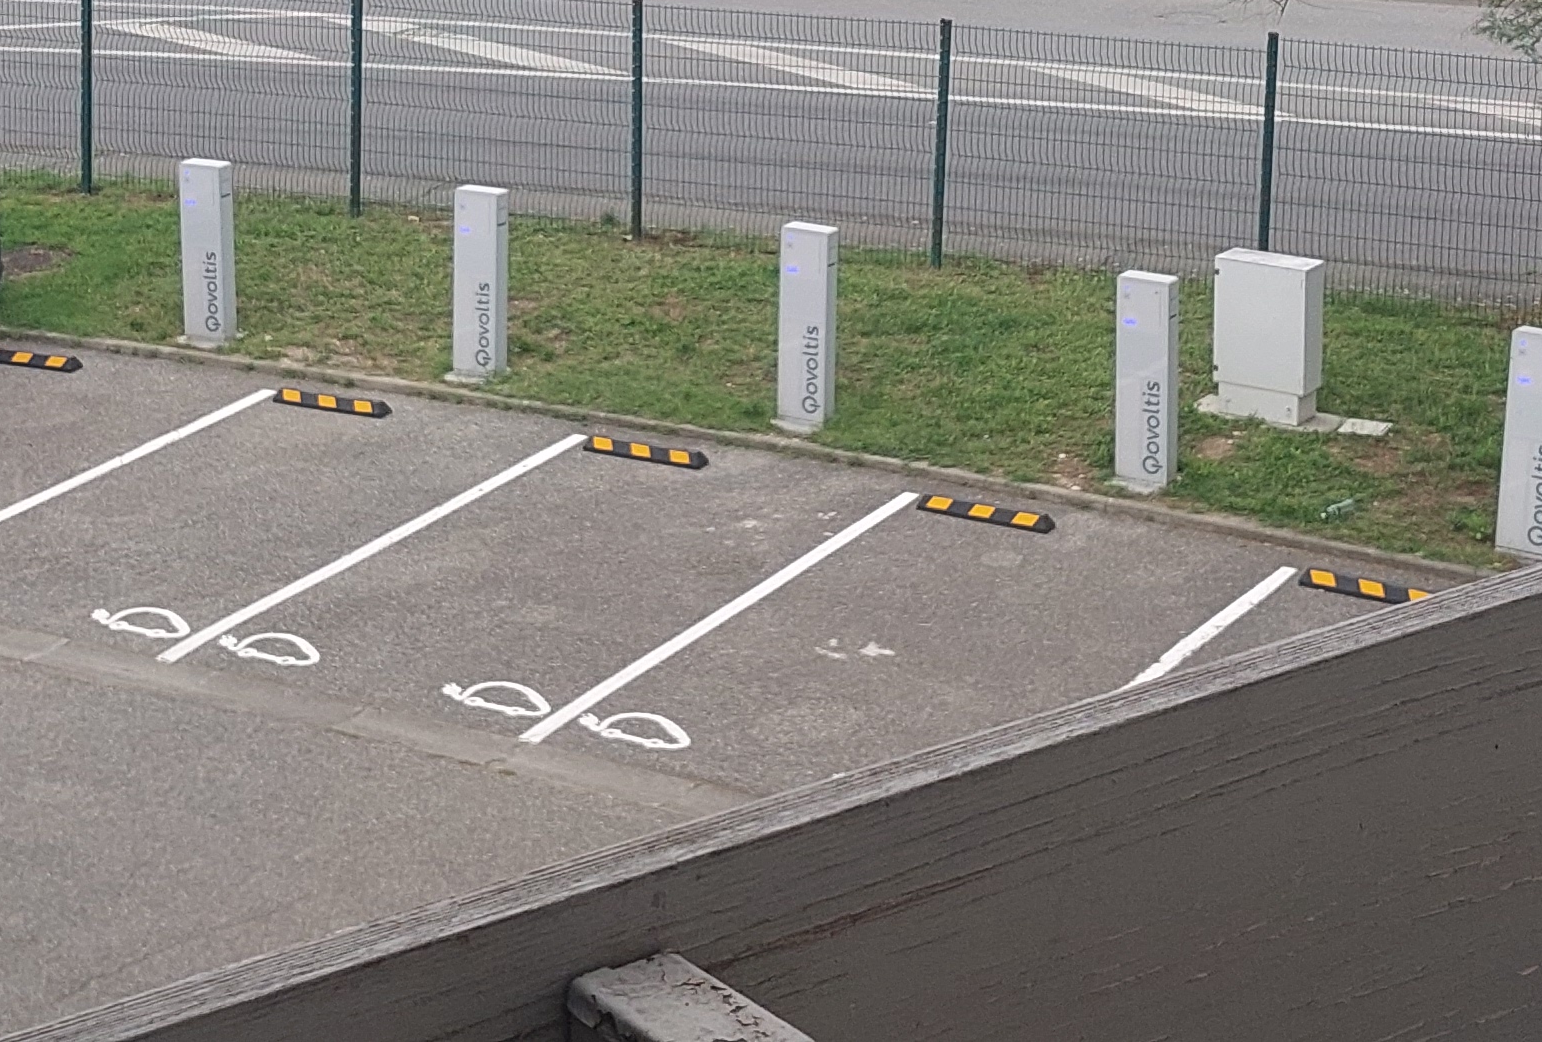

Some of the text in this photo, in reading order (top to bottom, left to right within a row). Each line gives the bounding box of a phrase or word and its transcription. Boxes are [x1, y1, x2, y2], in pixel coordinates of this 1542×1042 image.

[202, 251, 221, 333] Qovoltis
[474, 281, 492, 367] Qovoltis
[802, 324, 821, 415] Qovoltis
[1142, 380, 1163, 475] Qovoltis
